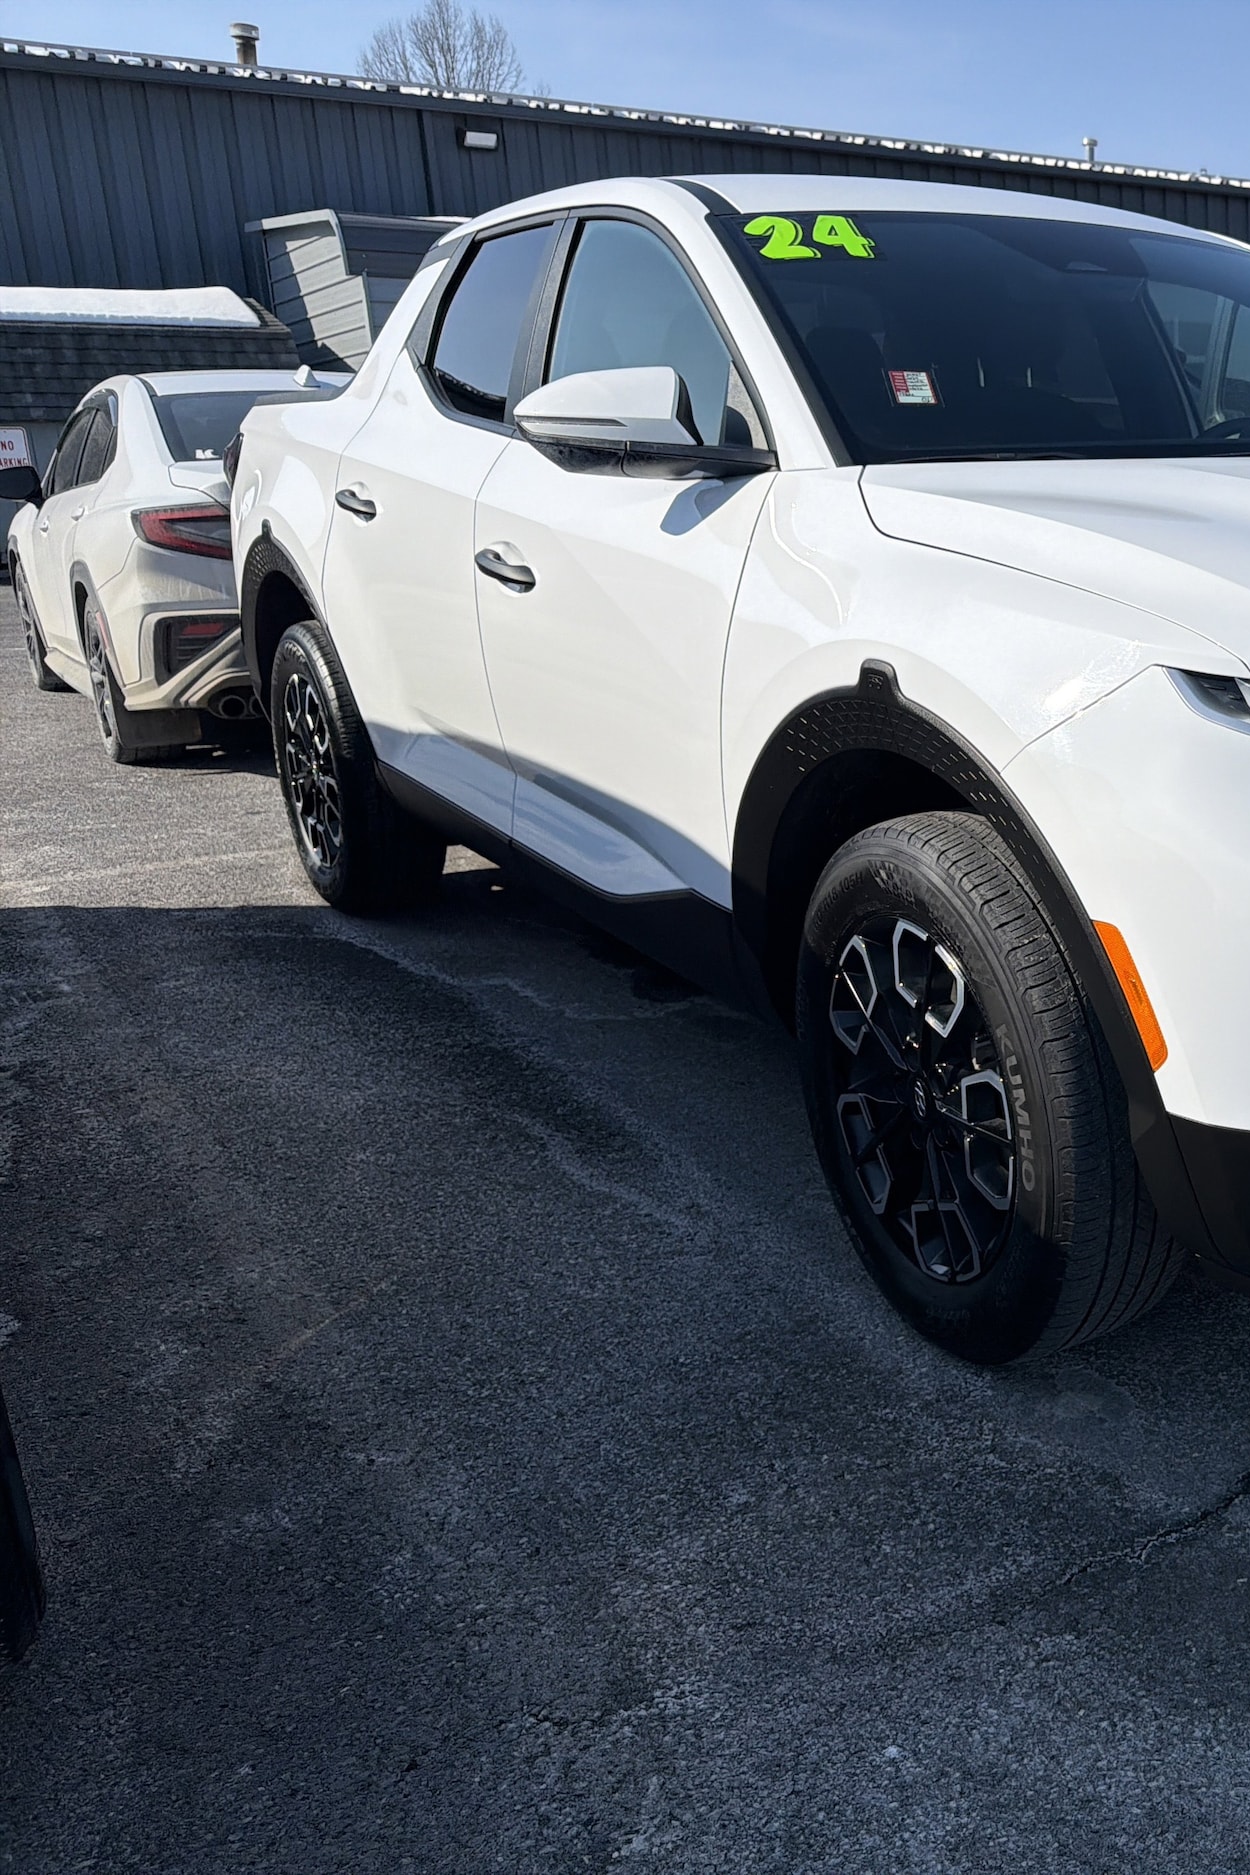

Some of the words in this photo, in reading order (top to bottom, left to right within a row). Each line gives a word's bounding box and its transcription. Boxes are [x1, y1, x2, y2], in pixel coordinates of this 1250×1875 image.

[743, 214, 875, 260] 24
[0, 440, 14, 451] NO
[0, 457, 27, 467] ARKING
[995, 1023, 1036, 1192] KUMHO
